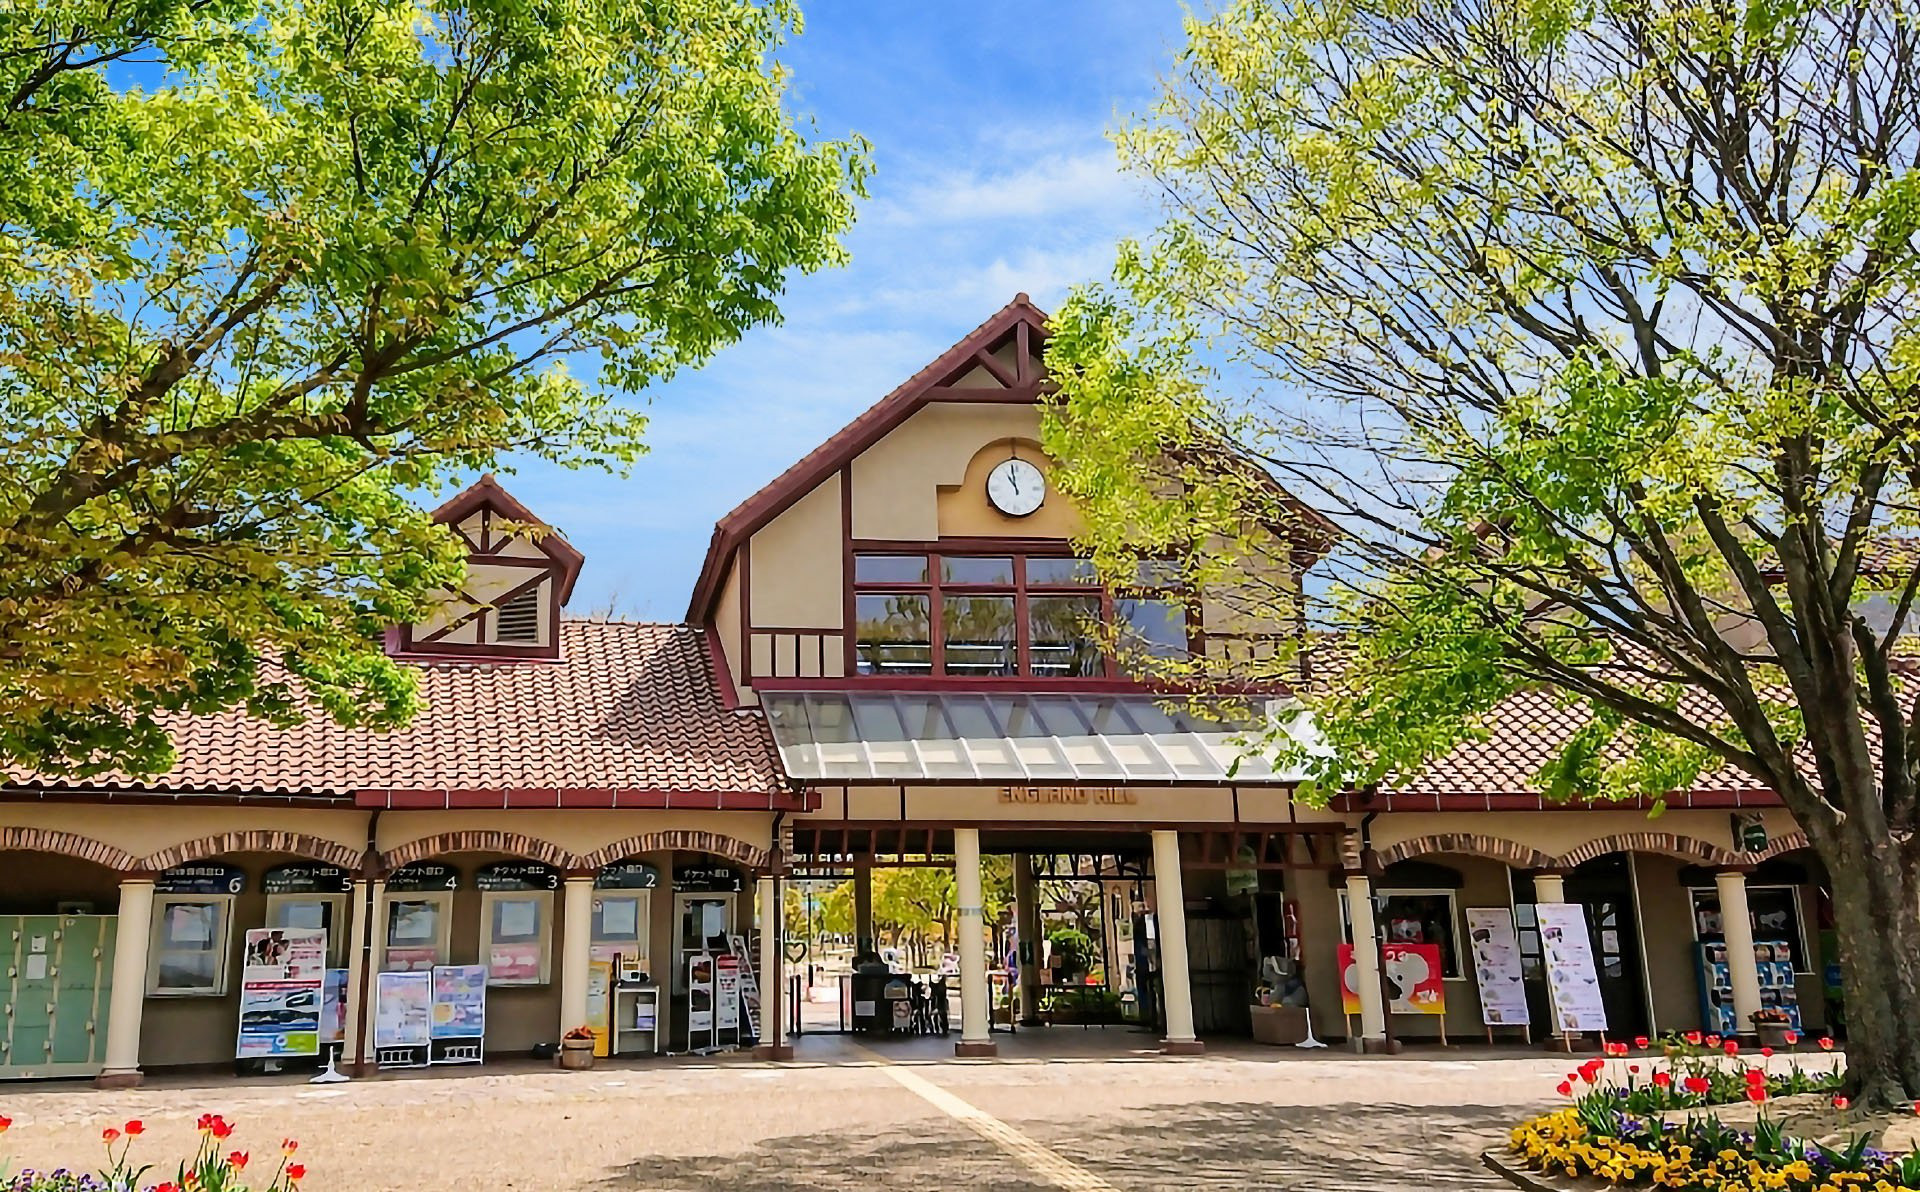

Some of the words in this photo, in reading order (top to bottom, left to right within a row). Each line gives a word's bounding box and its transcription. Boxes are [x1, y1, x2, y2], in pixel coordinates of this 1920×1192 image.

[998, 787, 1088, 805] ENGLAND
[1094, 787, 1137, 805] HILL
[229, 877, 242, 893] 6
[341, 877, 353, 891] 5
[445, 875, 457, 890] 4
[547, 875, 558, 889] 3
[645, 873, 656, 887] 2
[733, 878, 742, 891] 1
